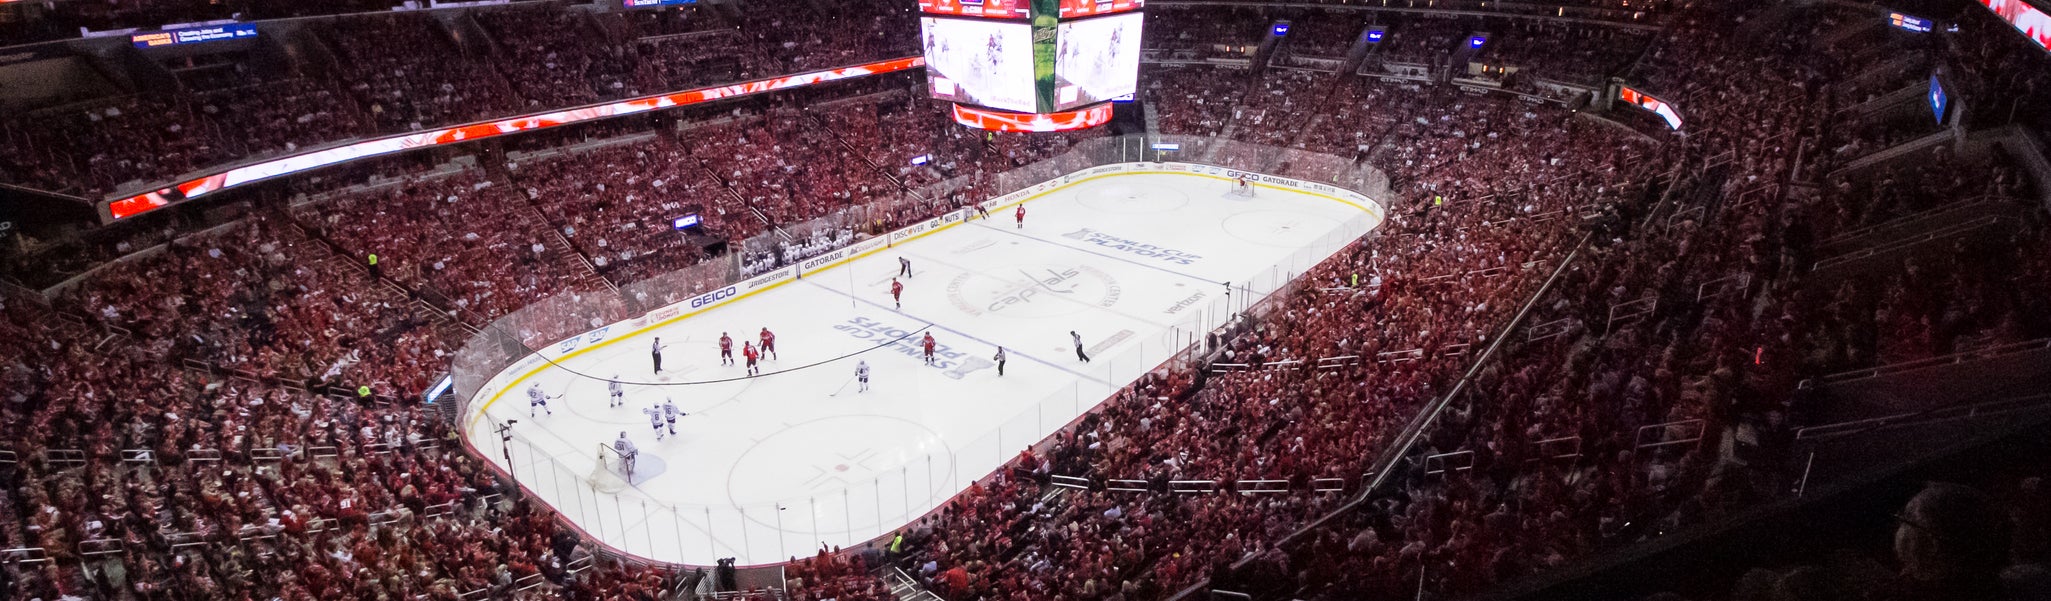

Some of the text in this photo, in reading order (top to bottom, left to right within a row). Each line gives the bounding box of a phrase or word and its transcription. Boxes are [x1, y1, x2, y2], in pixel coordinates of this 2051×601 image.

[1460, 86, 1489, 94] ETIHAD
[1226, 170, 1260, 181] GECO
[1262, 176, 1299, 188] GATORADE
[1004, 190, 1031, 203] HONDA
[894, 225, 925, 240] DISCOVER
[1083, 237, 1196, 265] PLAYOFFS
[1163, 248, 1203, 260] CUP
[804, 251, 844, 270] GATORADE
[691, 286, 737, 309] GEICO
[833, 324, 874, 339] CUP
